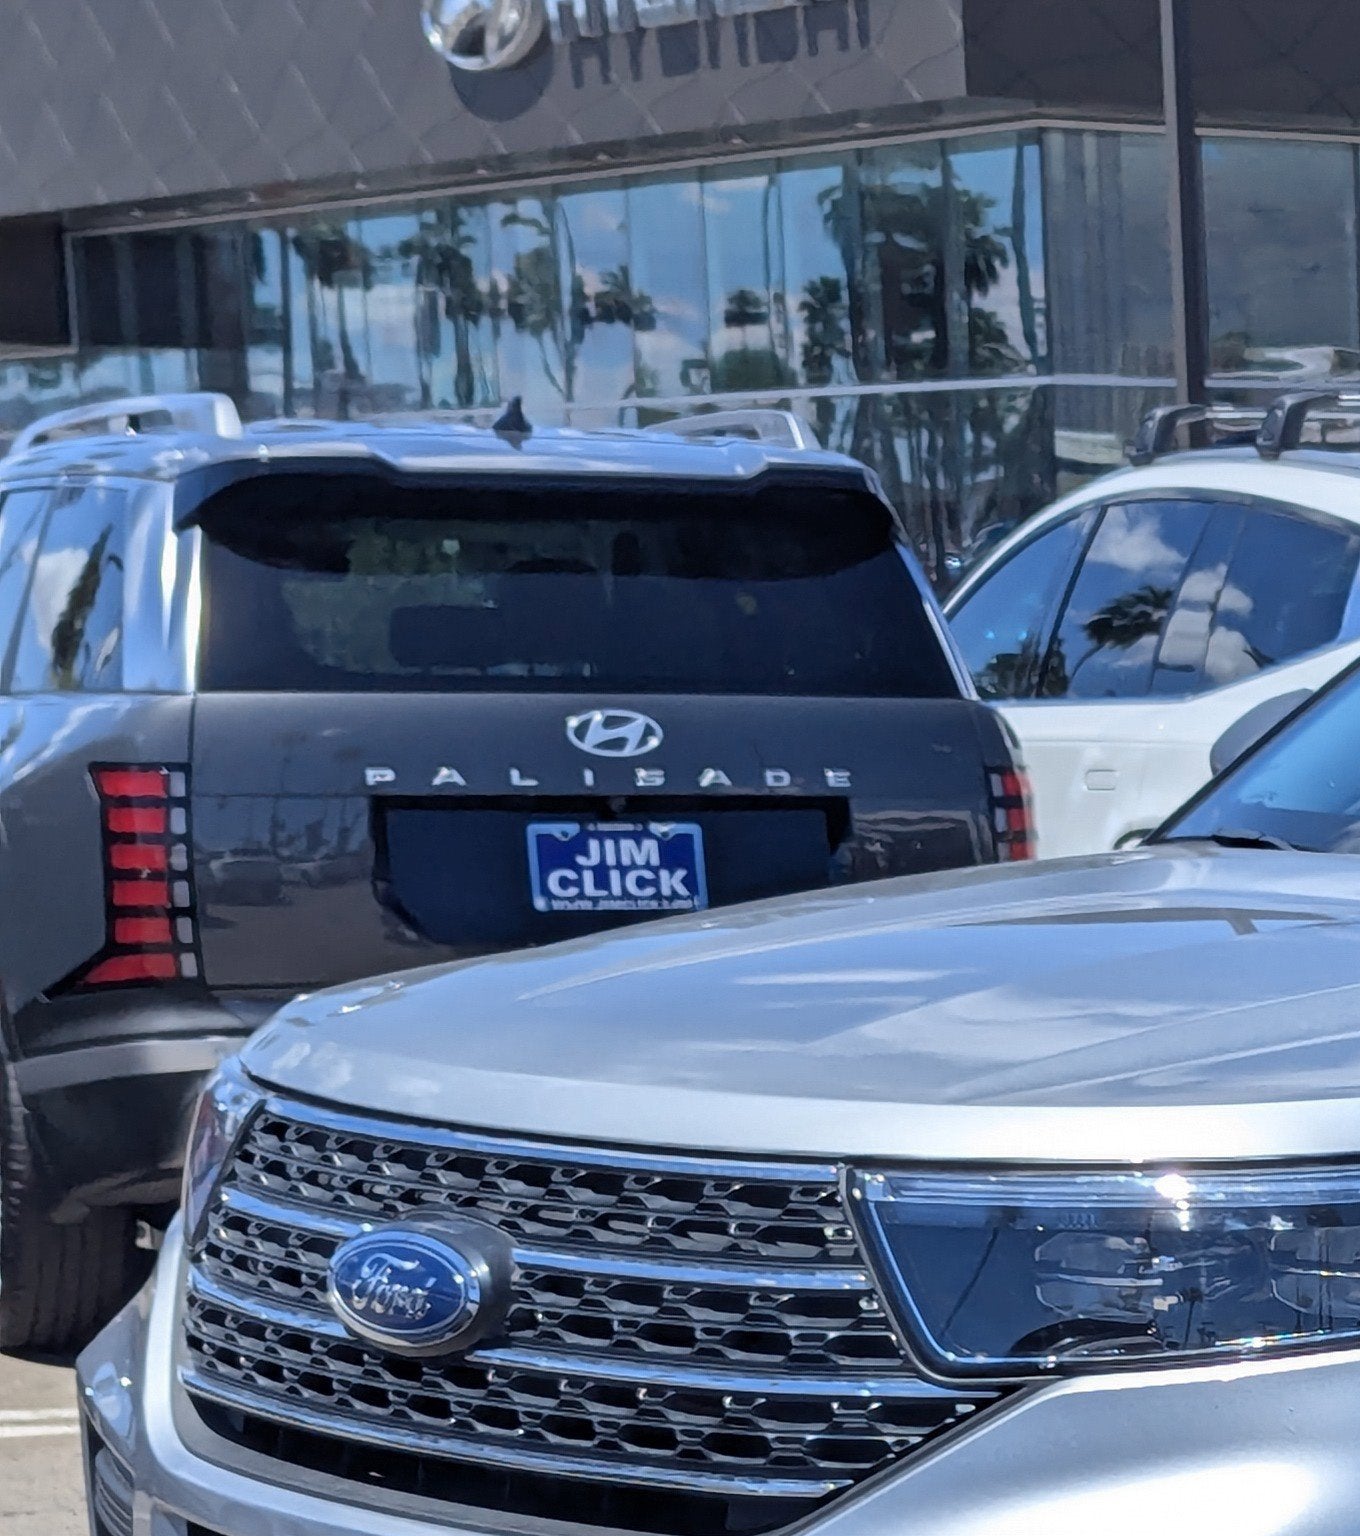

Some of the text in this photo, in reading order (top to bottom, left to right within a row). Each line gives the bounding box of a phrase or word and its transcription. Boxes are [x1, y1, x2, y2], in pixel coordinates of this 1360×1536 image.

[365, 767, 851, 787] PALISADE
[575, 838, 660, 867] JIM
[547, 868, 691, 897] CLICK
[352, 1252, 437, 1320] Ford
